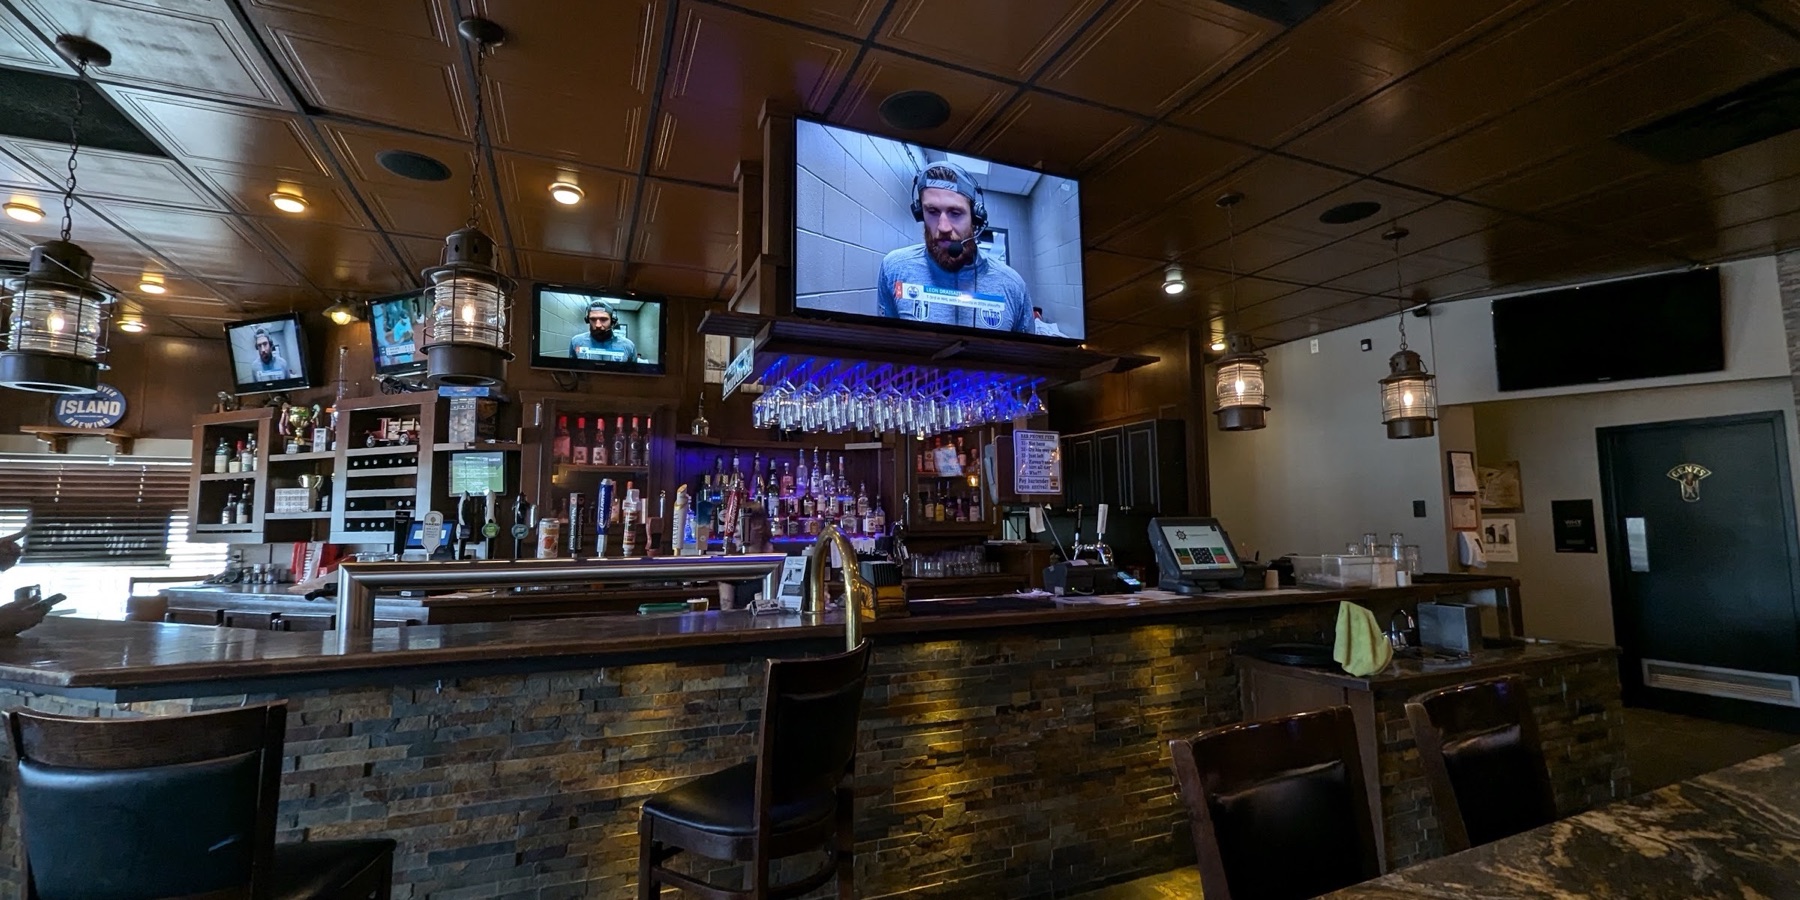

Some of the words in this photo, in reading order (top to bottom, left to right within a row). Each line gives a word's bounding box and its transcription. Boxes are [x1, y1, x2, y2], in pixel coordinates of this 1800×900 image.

[59, 400, 121, 416] ISLAND
[65, 417, 110, 428] BREWING
[1671, 466, 1706, 477] GENTS
[728, 496, 738, 532] Budweiser
